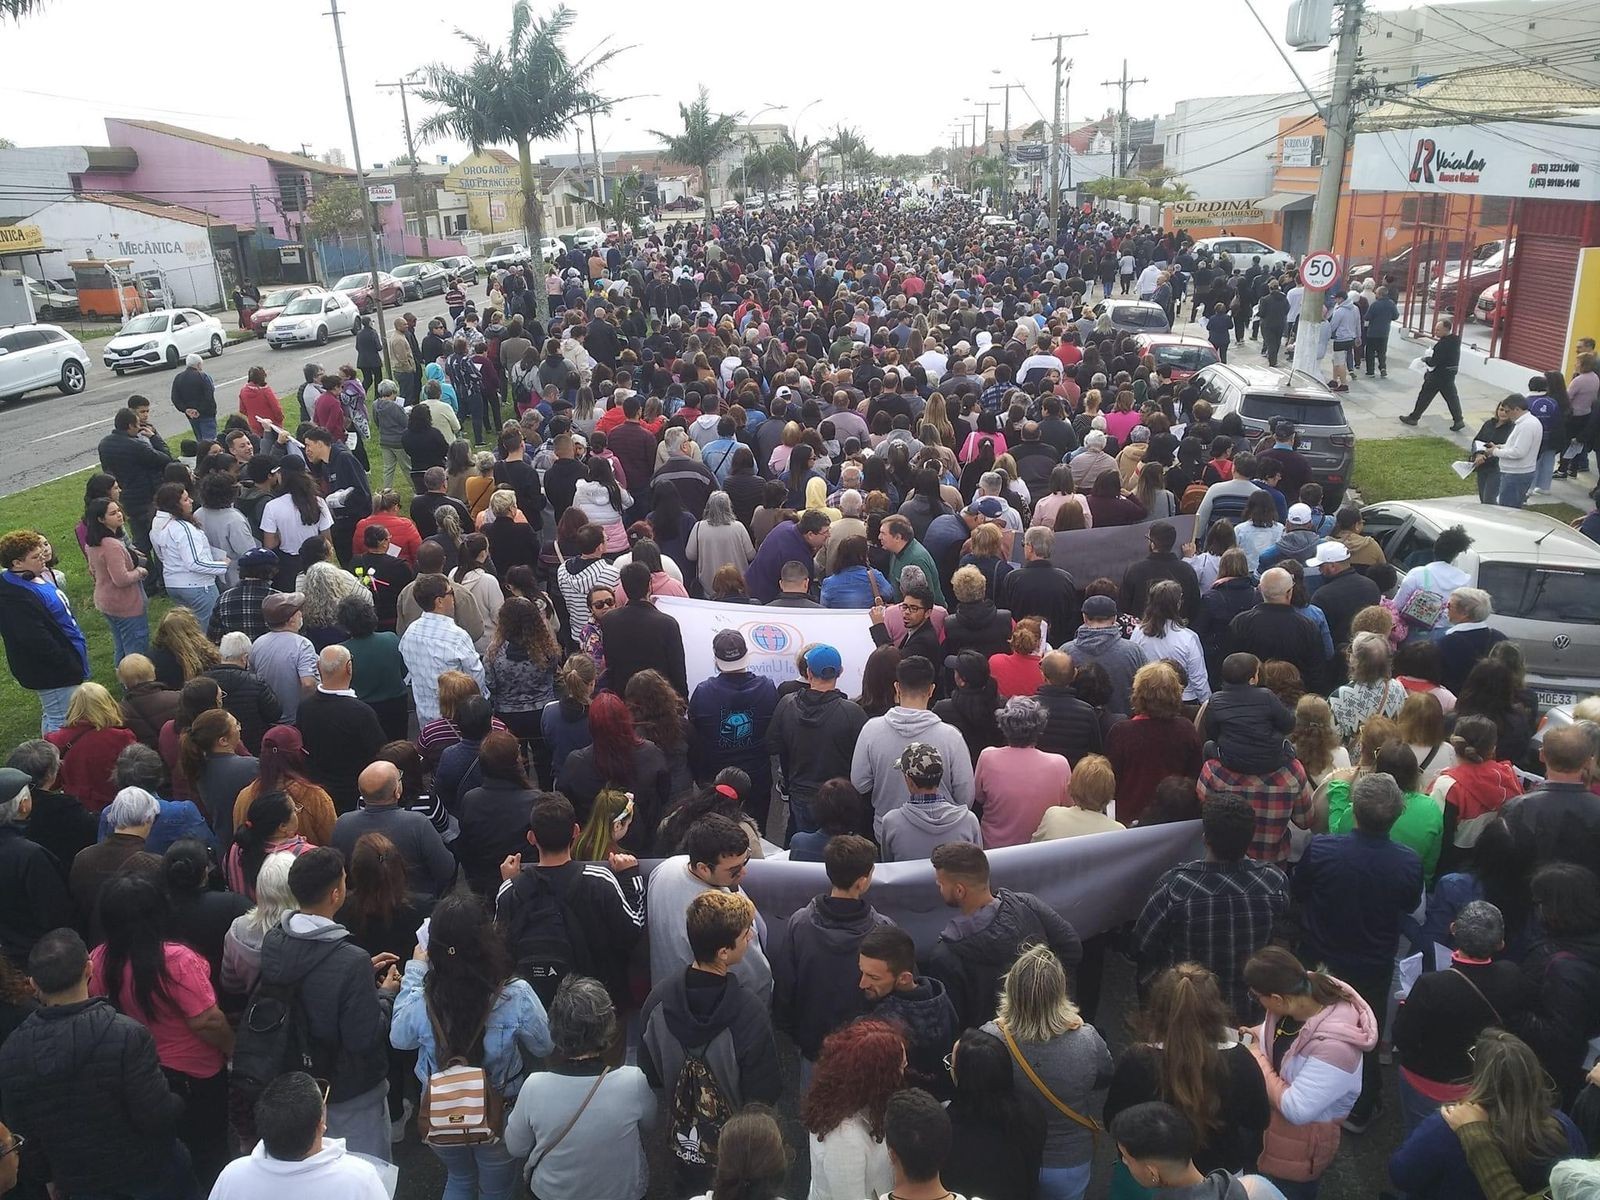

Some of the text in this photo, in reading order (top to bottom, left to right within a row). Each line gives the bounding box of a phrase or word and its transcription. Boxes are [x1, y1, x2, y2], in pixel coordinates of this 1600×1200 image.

[463, 165, 510, 174] DROGARIA
[0, 229, 26, 242] NICA
[1309, 259, 1334, 278] 50
[676, 1150, 706, 1164] adidas
